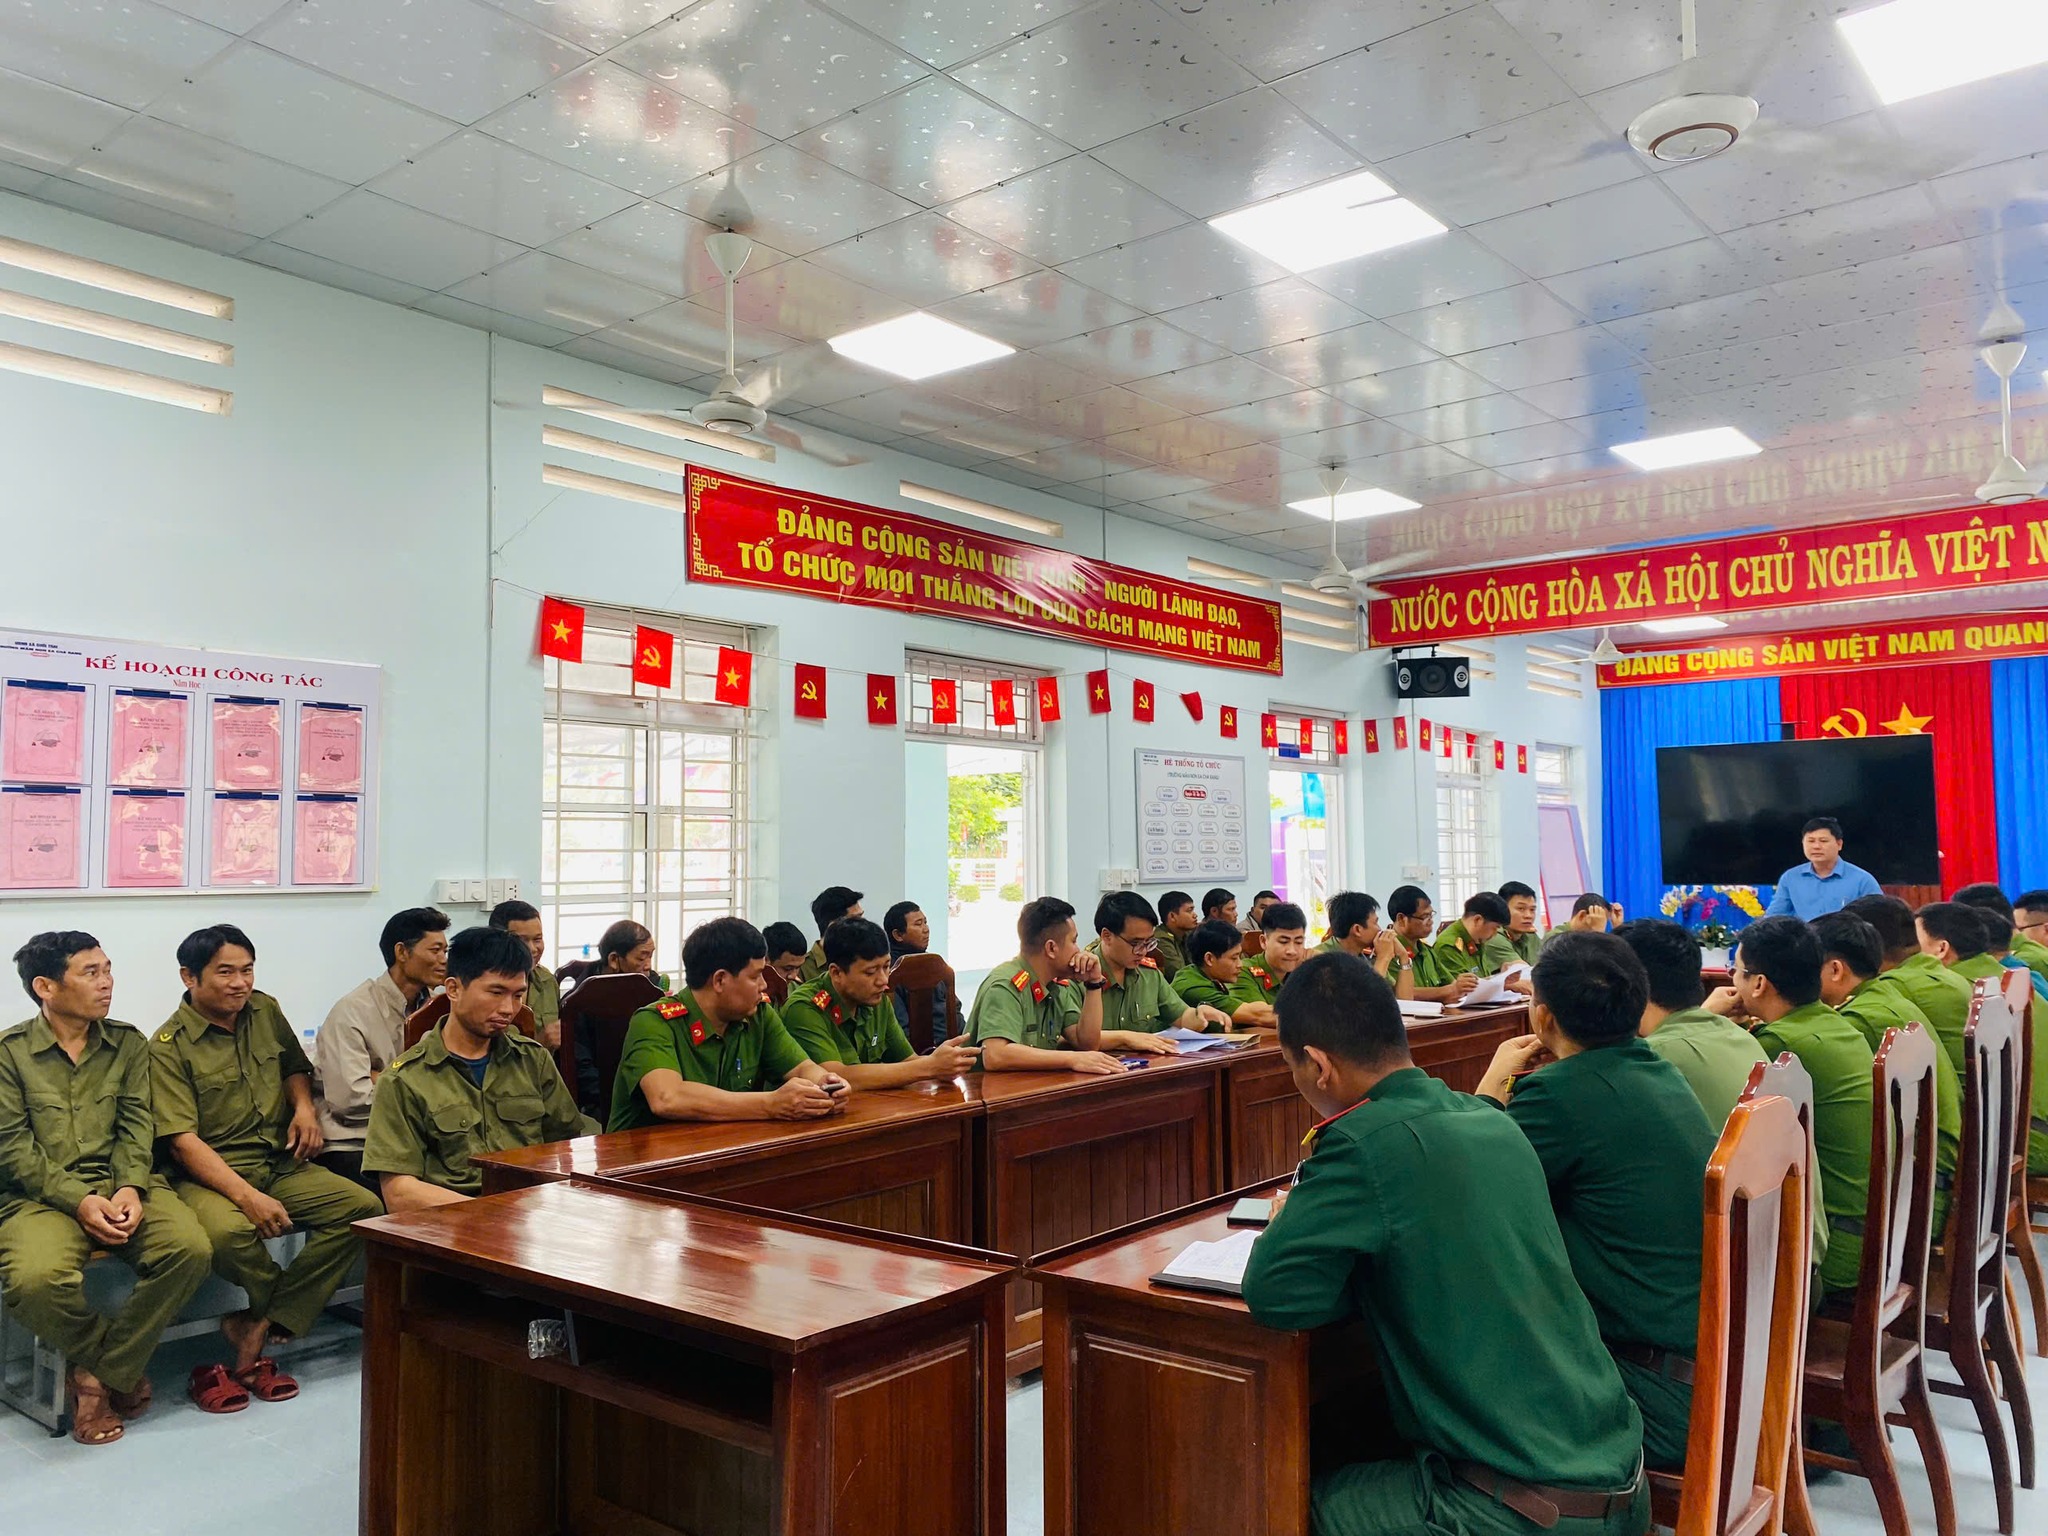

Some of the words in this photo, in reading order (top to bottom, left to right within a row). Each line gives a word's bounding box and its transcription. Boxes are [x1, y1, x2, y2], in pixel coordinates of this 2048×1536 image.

[737, 537, 774, 572] TỔ
[783, 551, 856, 586] CHỨC
[864, 565, 914, 598] MỌI
[921, 573, 996, 610] THẮNG
[1003, 591, 1035, 620] LỢI
[1041, 597, 1080, 626] CỦA
[1085, 608, 1134, 636] CÁCH
[1138, 619, 1187, 646] MẠNG
[1191, 629, 1223, 655] VIỆT
[1227, 636, 1261, 659] NAM
[777, 504, 854, 546] ĐẢNG
[862, 525, 930, 561] CỘNG
[938, 539, 985, 572] SẢN
[991, 554, 1035, 584] VIỆT
[1039, 566, 1087, 595] NAM
[1104, 580, 1158, 610] NGƯỜI
[1162, 592, 1204, 620] LÃNH
[1207, 603, 1241, 630] ĐẠO,
[1391, 584, 1458, 633] NƯỚC
[1466, 577, 1539, 632] CỘNG
[1547, 567, 1607, 617] HÒA
[1614, 559, 1656, 609] XÃ
[1665, 552, 1719, 611] HỘI
[1729, 537, 1795, 598] CHỦ
[1806, 530, 1918, 590] NGHĨA
[1925, 516, 2016, 582] VIỆT
[85, 654, 117, 670] KẾ
[125, 660, 206, 678] HOẠCH
[214, 667, 274, 684] CÔNG
[281, 673, 323, 688] TÁC
[1761, 637, 1816, 665] SẢN
[1823, 633, 1879, 663] VIỆT
[1889, 628, 1955, 654] NAM
[1965, 621, 2048, 650] QUAN
